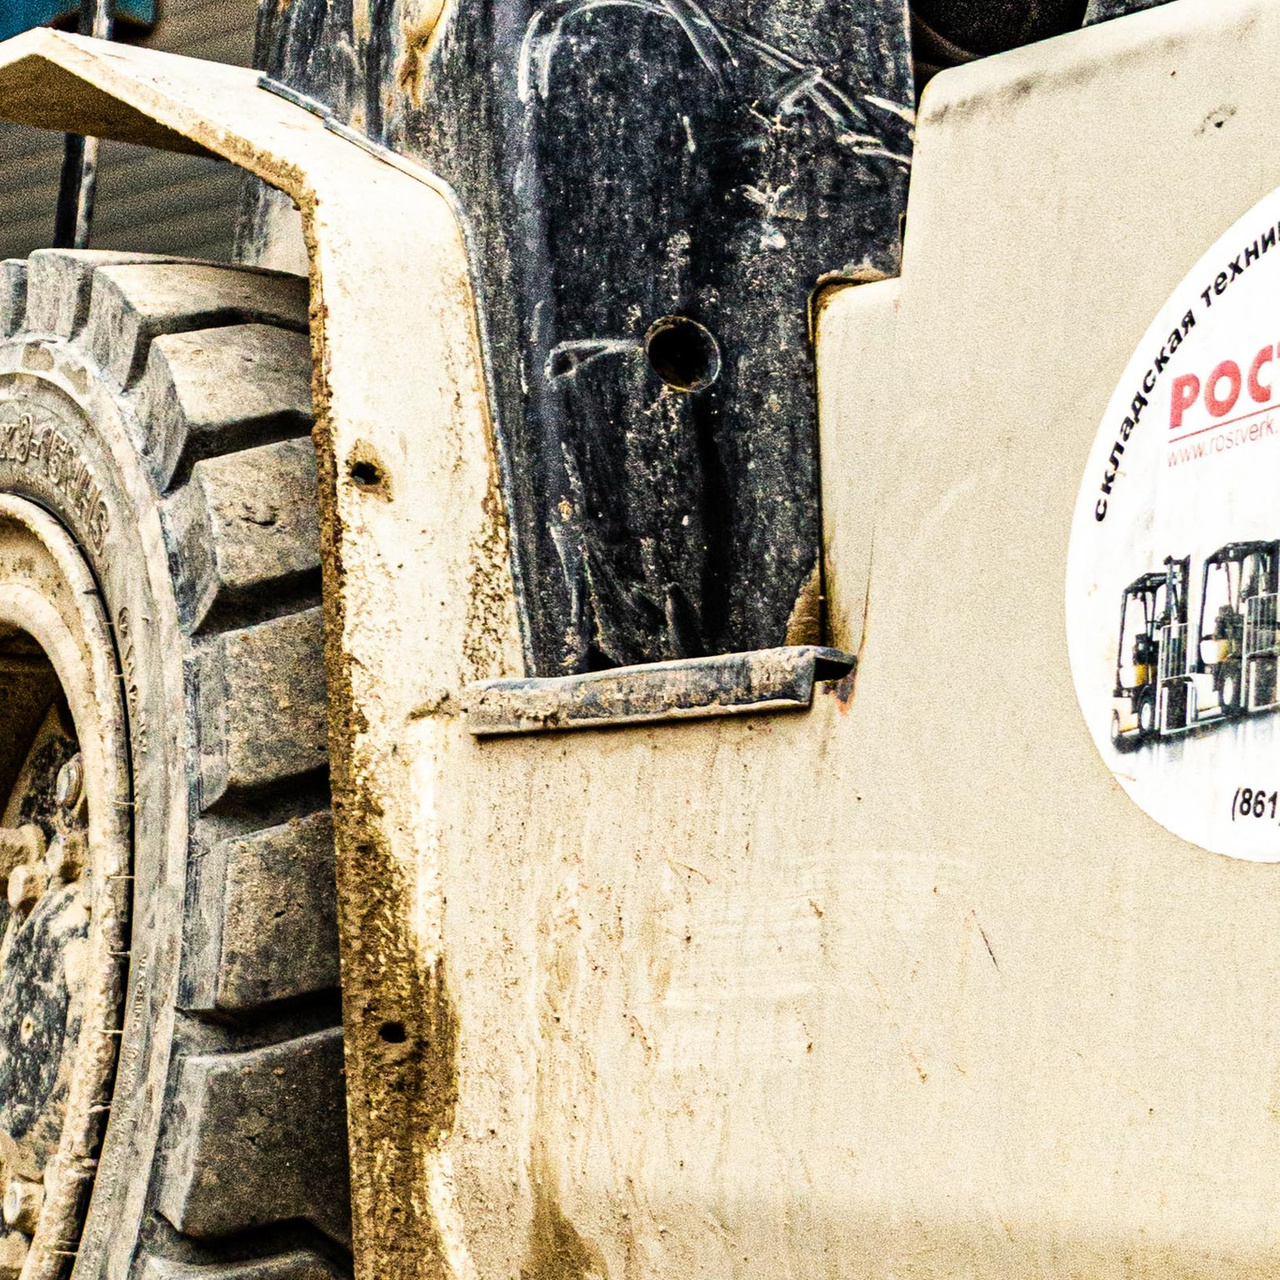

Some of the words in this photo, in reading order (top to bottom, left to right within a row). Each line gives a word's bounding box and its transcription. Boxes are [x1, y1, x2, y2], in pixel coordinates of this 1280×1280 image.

[1095, 308, 1197, 522] складская
[1169, 341, 1280, 429] РОС
[1231, 786, 1280, 826] (861
